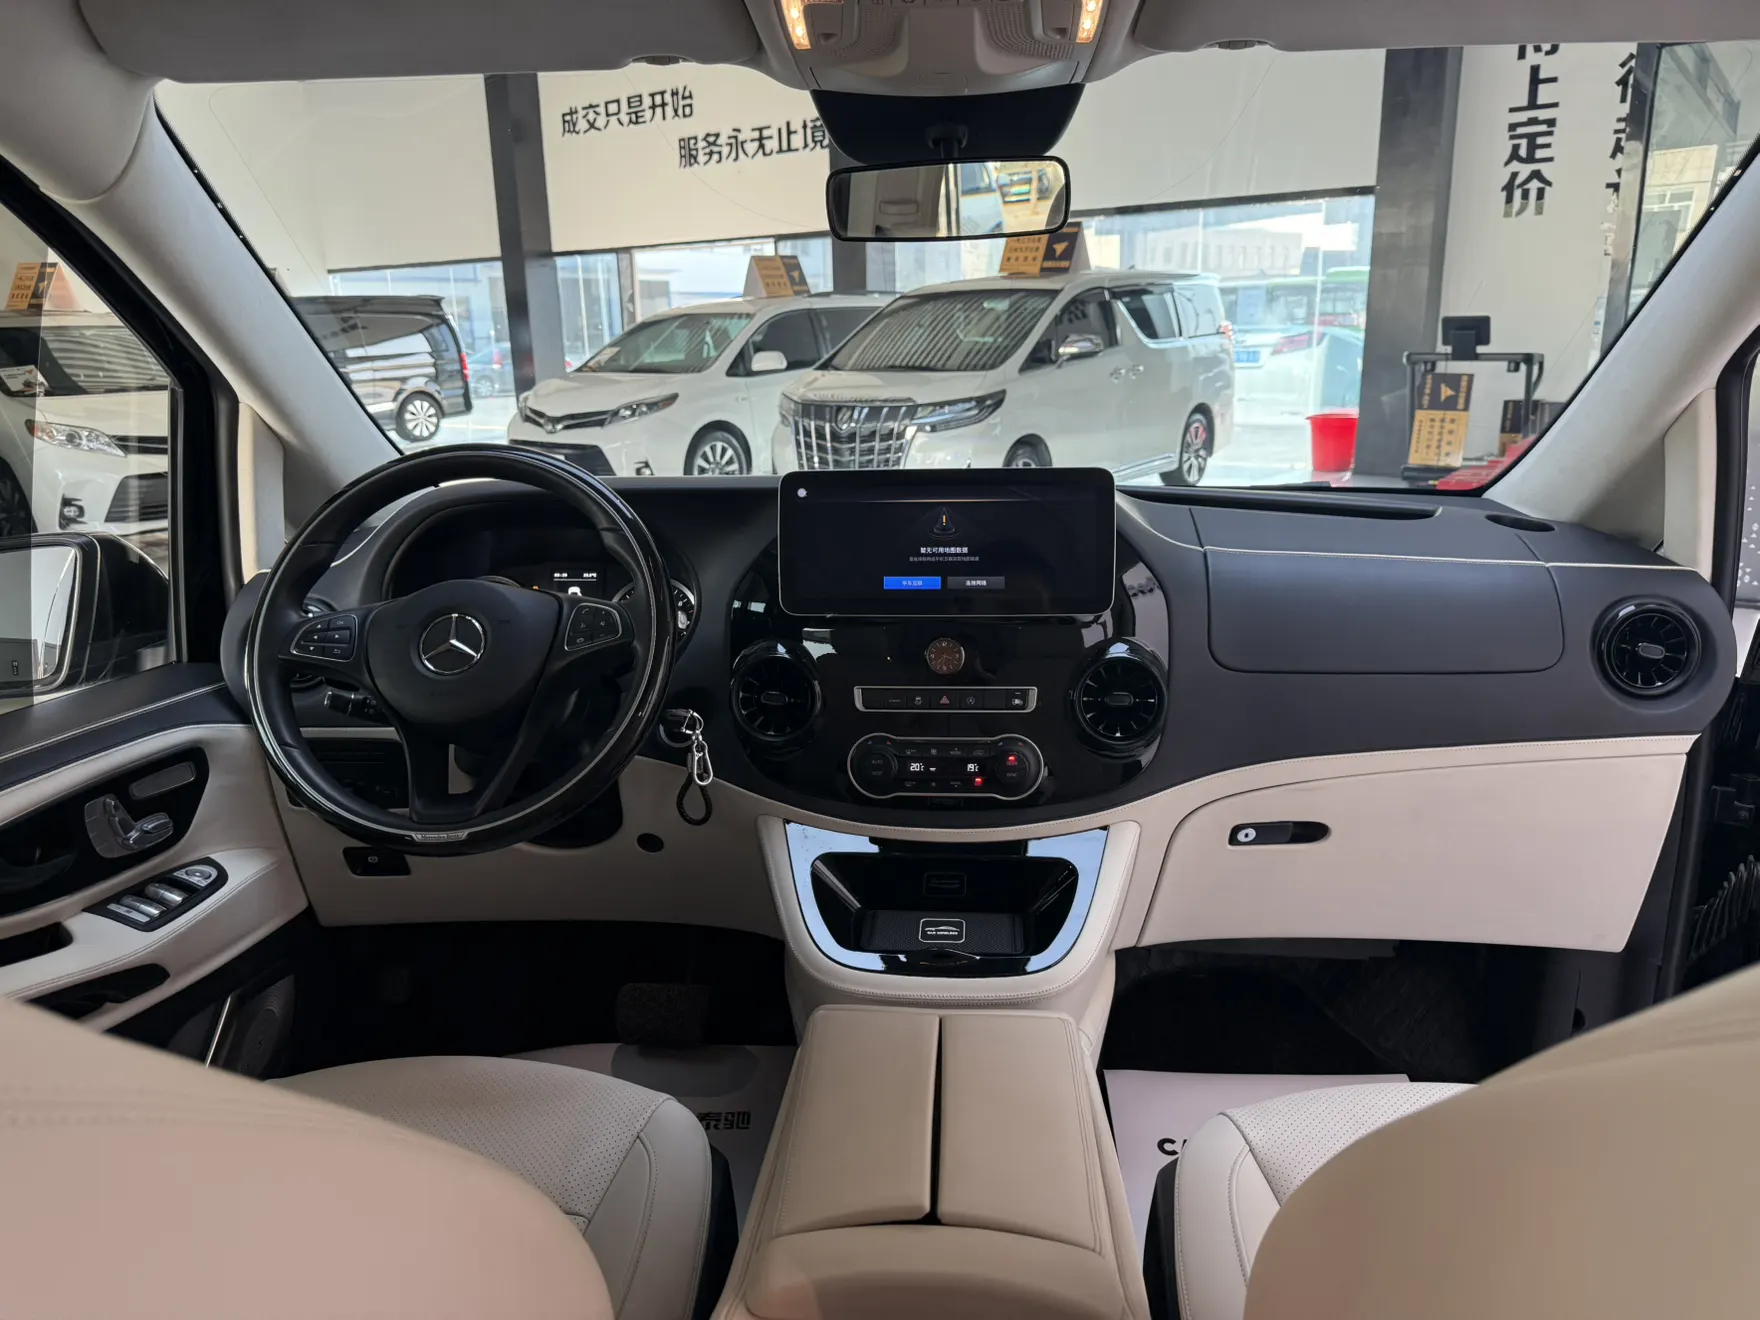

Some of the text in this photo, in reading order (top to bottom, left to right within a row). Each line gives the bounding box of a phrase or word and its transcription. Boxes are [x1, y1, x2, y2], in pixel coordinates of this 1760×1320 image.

[561, 85, 693, 137] 成交只是开始
[1500, 44, 1560, 218] 上定价
[678, 117, 829, 168] 服务永无止境
[1157, 1137, 1187, 1156] C
